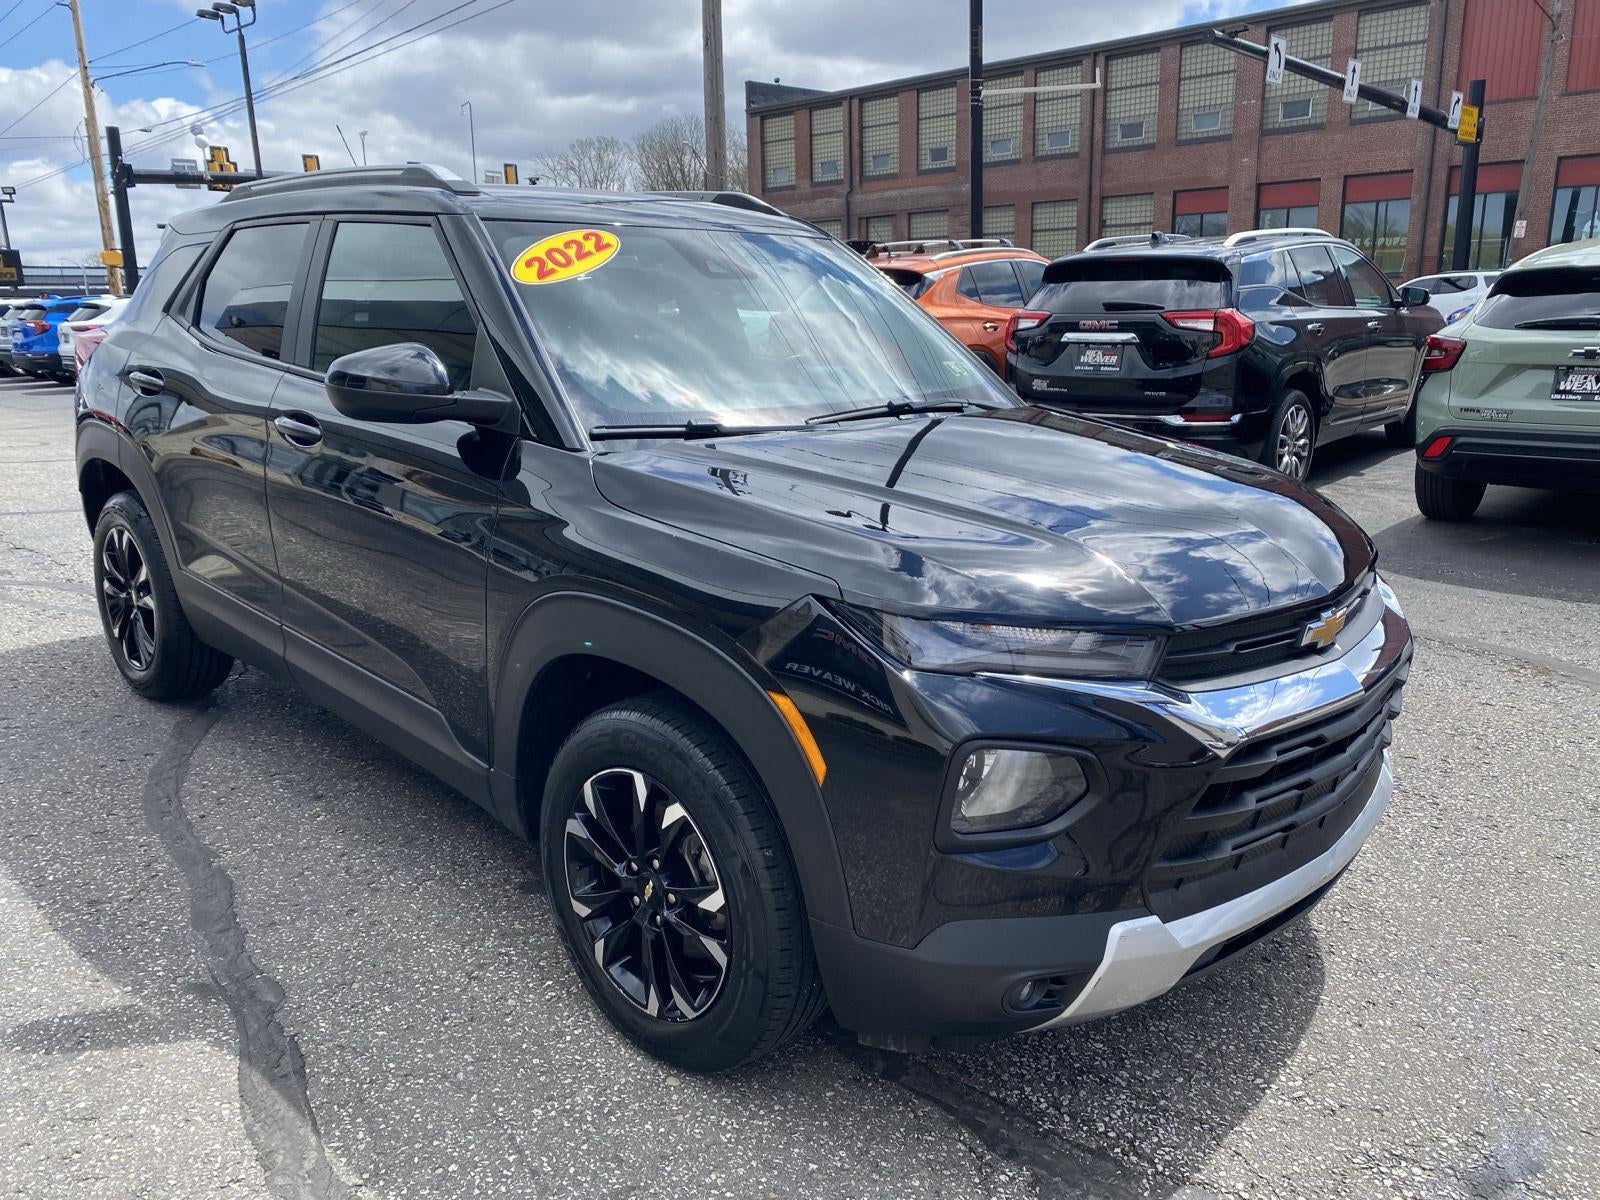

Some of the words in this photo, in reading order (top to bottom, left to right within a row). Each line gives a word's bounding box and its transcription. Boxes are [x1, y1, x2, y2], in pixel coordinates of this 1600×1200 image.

[1268, 70, 1281, 81] ONLY
[1345, 88, 1356, 98] ONLY
[525, 231, 613, 281] 2022
[1079, 319, 1119, 330] GMC
[1080, 354, 1118, 363] WEAVER
[1566, 374, 1598, 382] RICK
